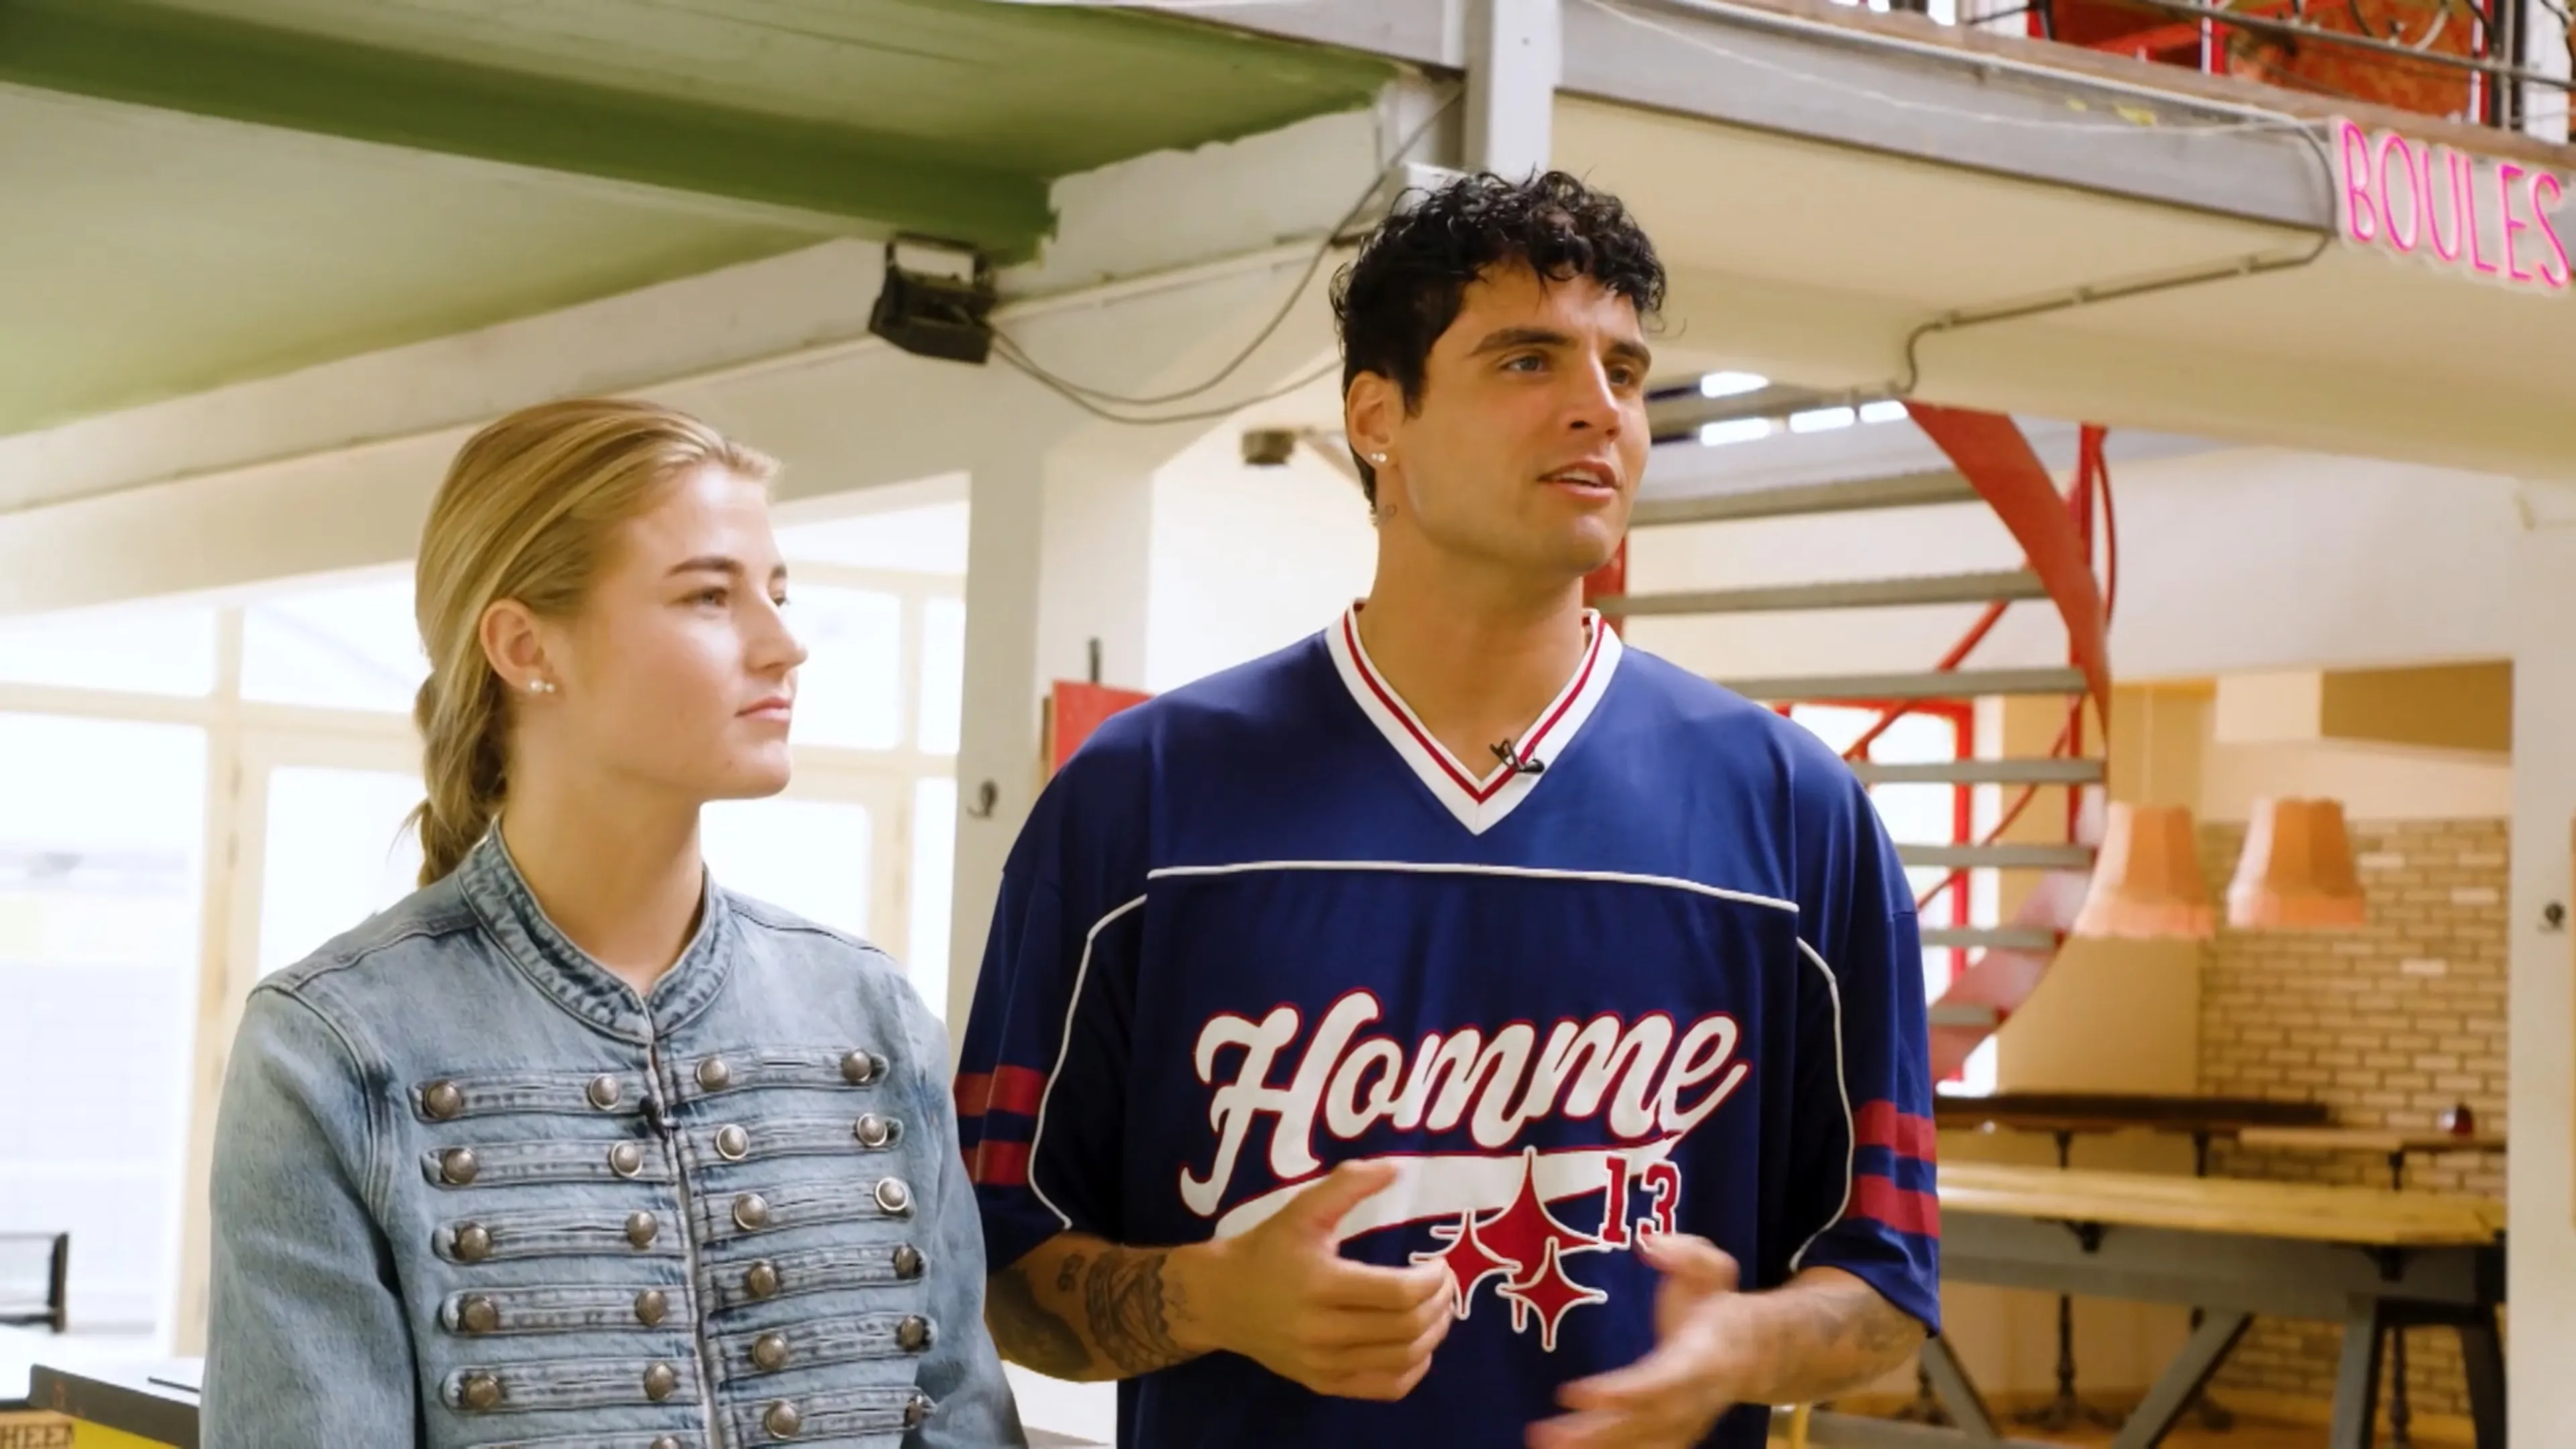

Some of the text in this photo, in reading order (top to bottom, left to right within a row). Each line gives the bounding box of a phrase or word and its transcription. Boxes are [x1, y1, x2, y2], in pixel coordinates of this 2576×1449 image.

[2342, 121, 2571, 287] BOULES
[1180, 988, 1749, 1216] Homme
[1599, 1155, 1681, 1250] 13
